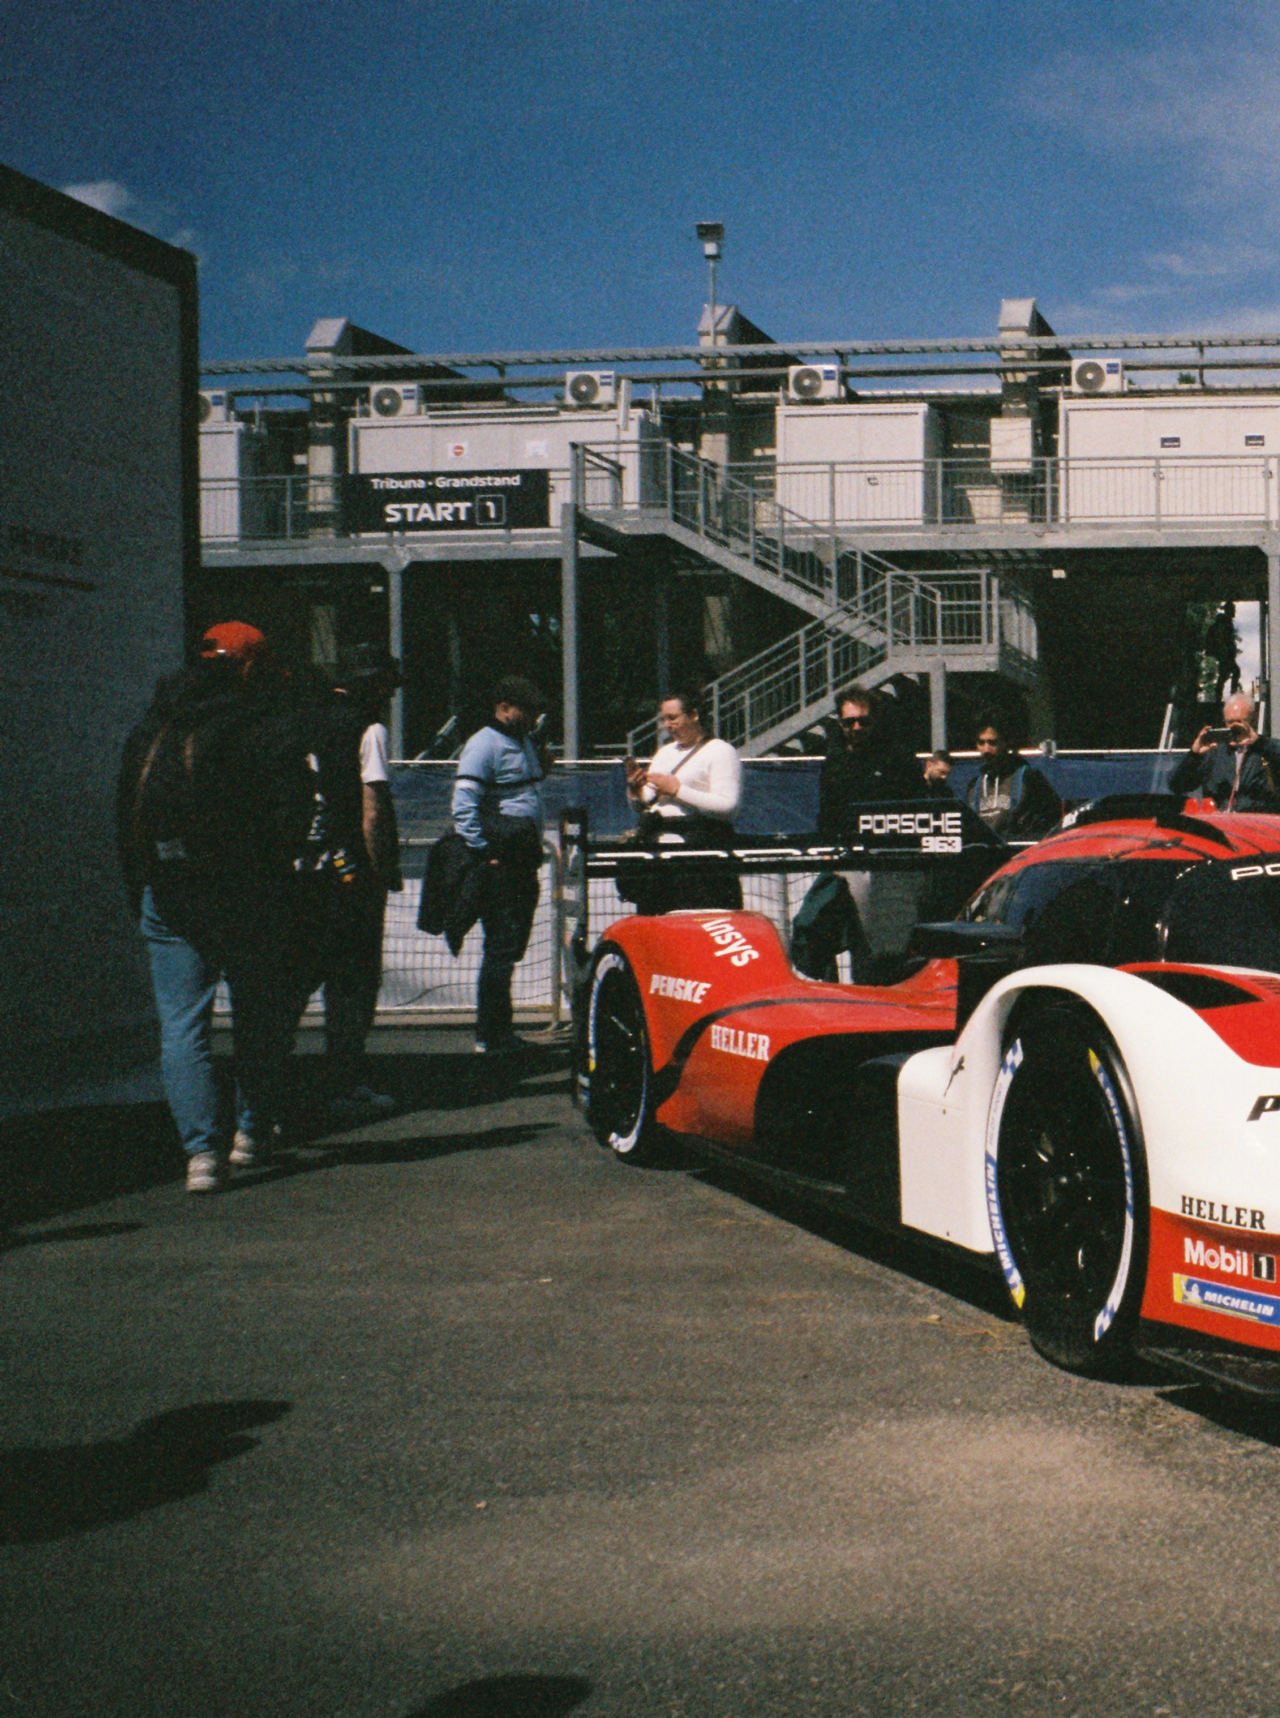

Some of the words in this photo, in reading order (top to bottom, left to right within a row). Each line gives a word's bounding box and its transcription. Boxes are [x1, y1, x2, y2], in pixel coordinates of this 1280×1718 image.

[371, 478, 426, 489] Tribuna
[435, 475, 521, 488] Grandstand
[385, 502, 472, 523] START
[485, 501, 496, 519] 1
[859, 812, 962, 834] PORSCHE
[921, 836, 962, 853] 963
[650, 973, 712, 1004] PENSKE
[711, 1024, 770, 1061] HELLER
[985, 1162, 1013, 1270] MICHELIN
[1181, 1195, 1266, 1231] HELLER
[1184, 1237, 1248, 1277] Mobil
[1204, 1290, 1275, 1317] MICHELIN
